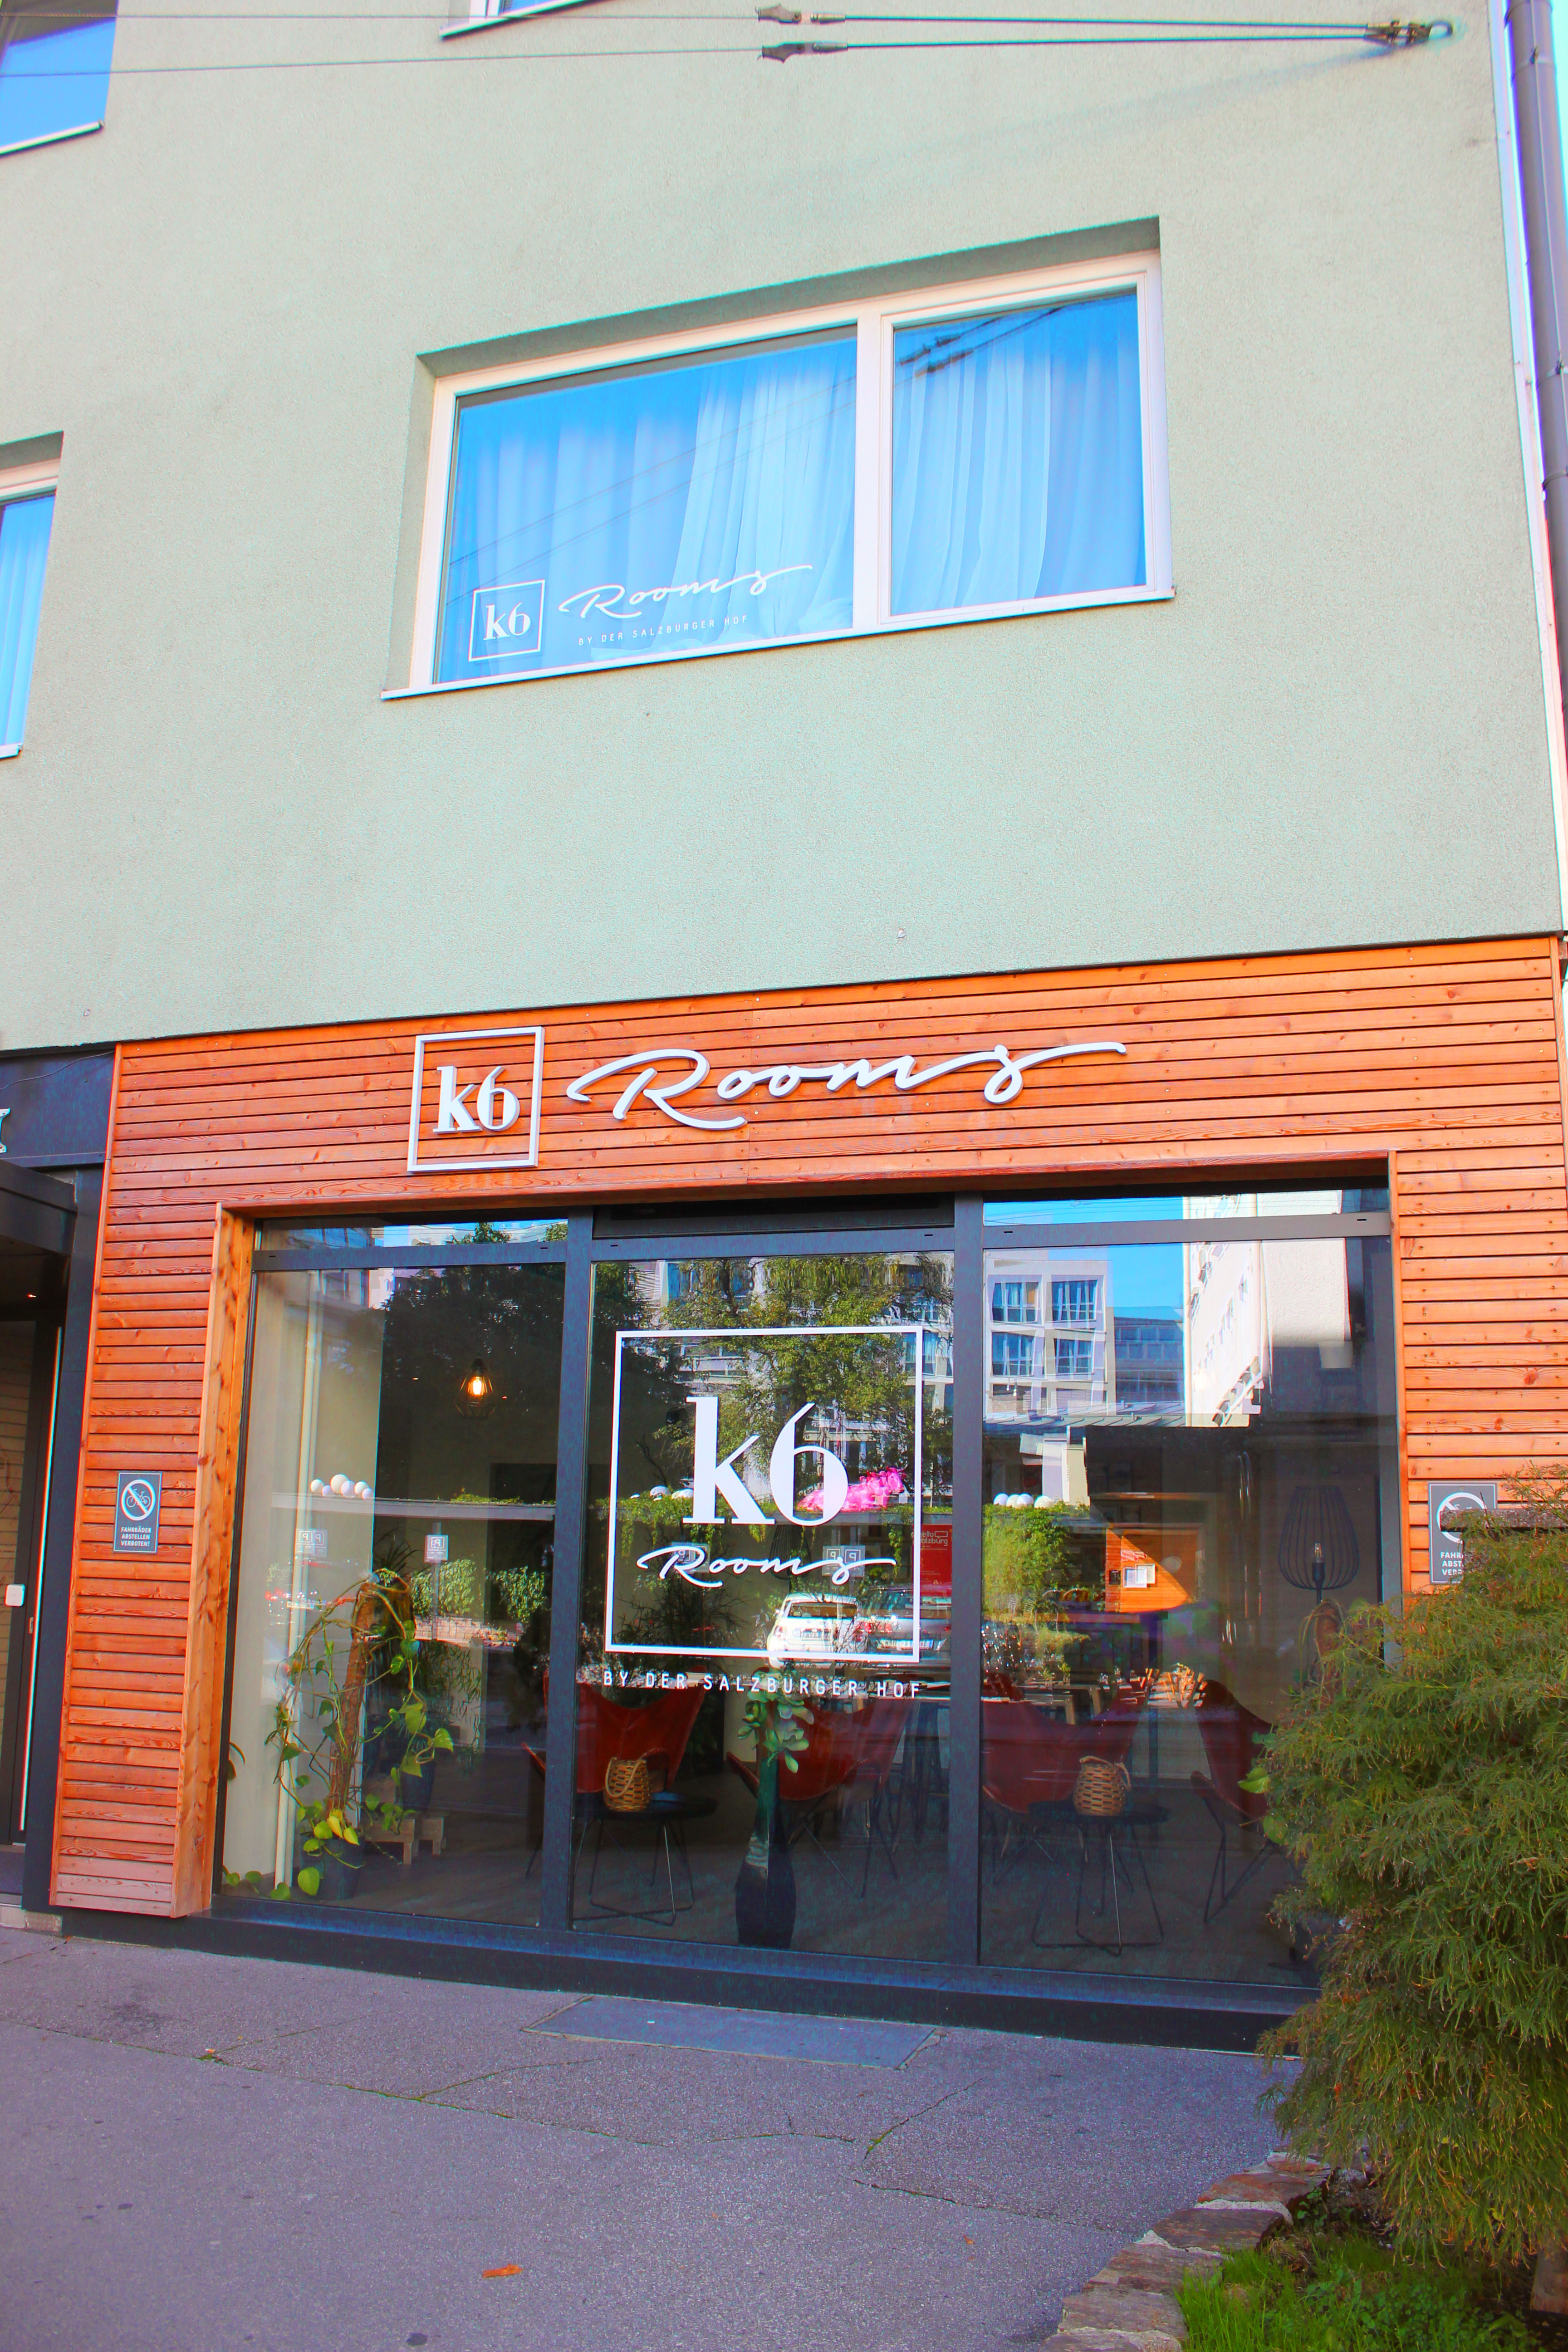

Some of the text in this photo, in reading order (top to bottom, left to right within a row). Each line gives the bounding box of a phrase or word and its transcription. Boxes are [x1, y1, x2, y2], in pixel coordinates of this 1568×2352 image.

[483, 565, 813, 641] k6 Rooms
[578, 614, 747, 646] BY DER SALZBURGER HOF
[432, 1042, 1127, 1133] k6 Rooms
[682, 1396, 848, 1526] k6
[921, 1537, 948, 1546] alzburg
[636, 1545, 897, 1588] Rooms
[603, 1671, 920, 1698] BY DER SALZBURGER HOF
